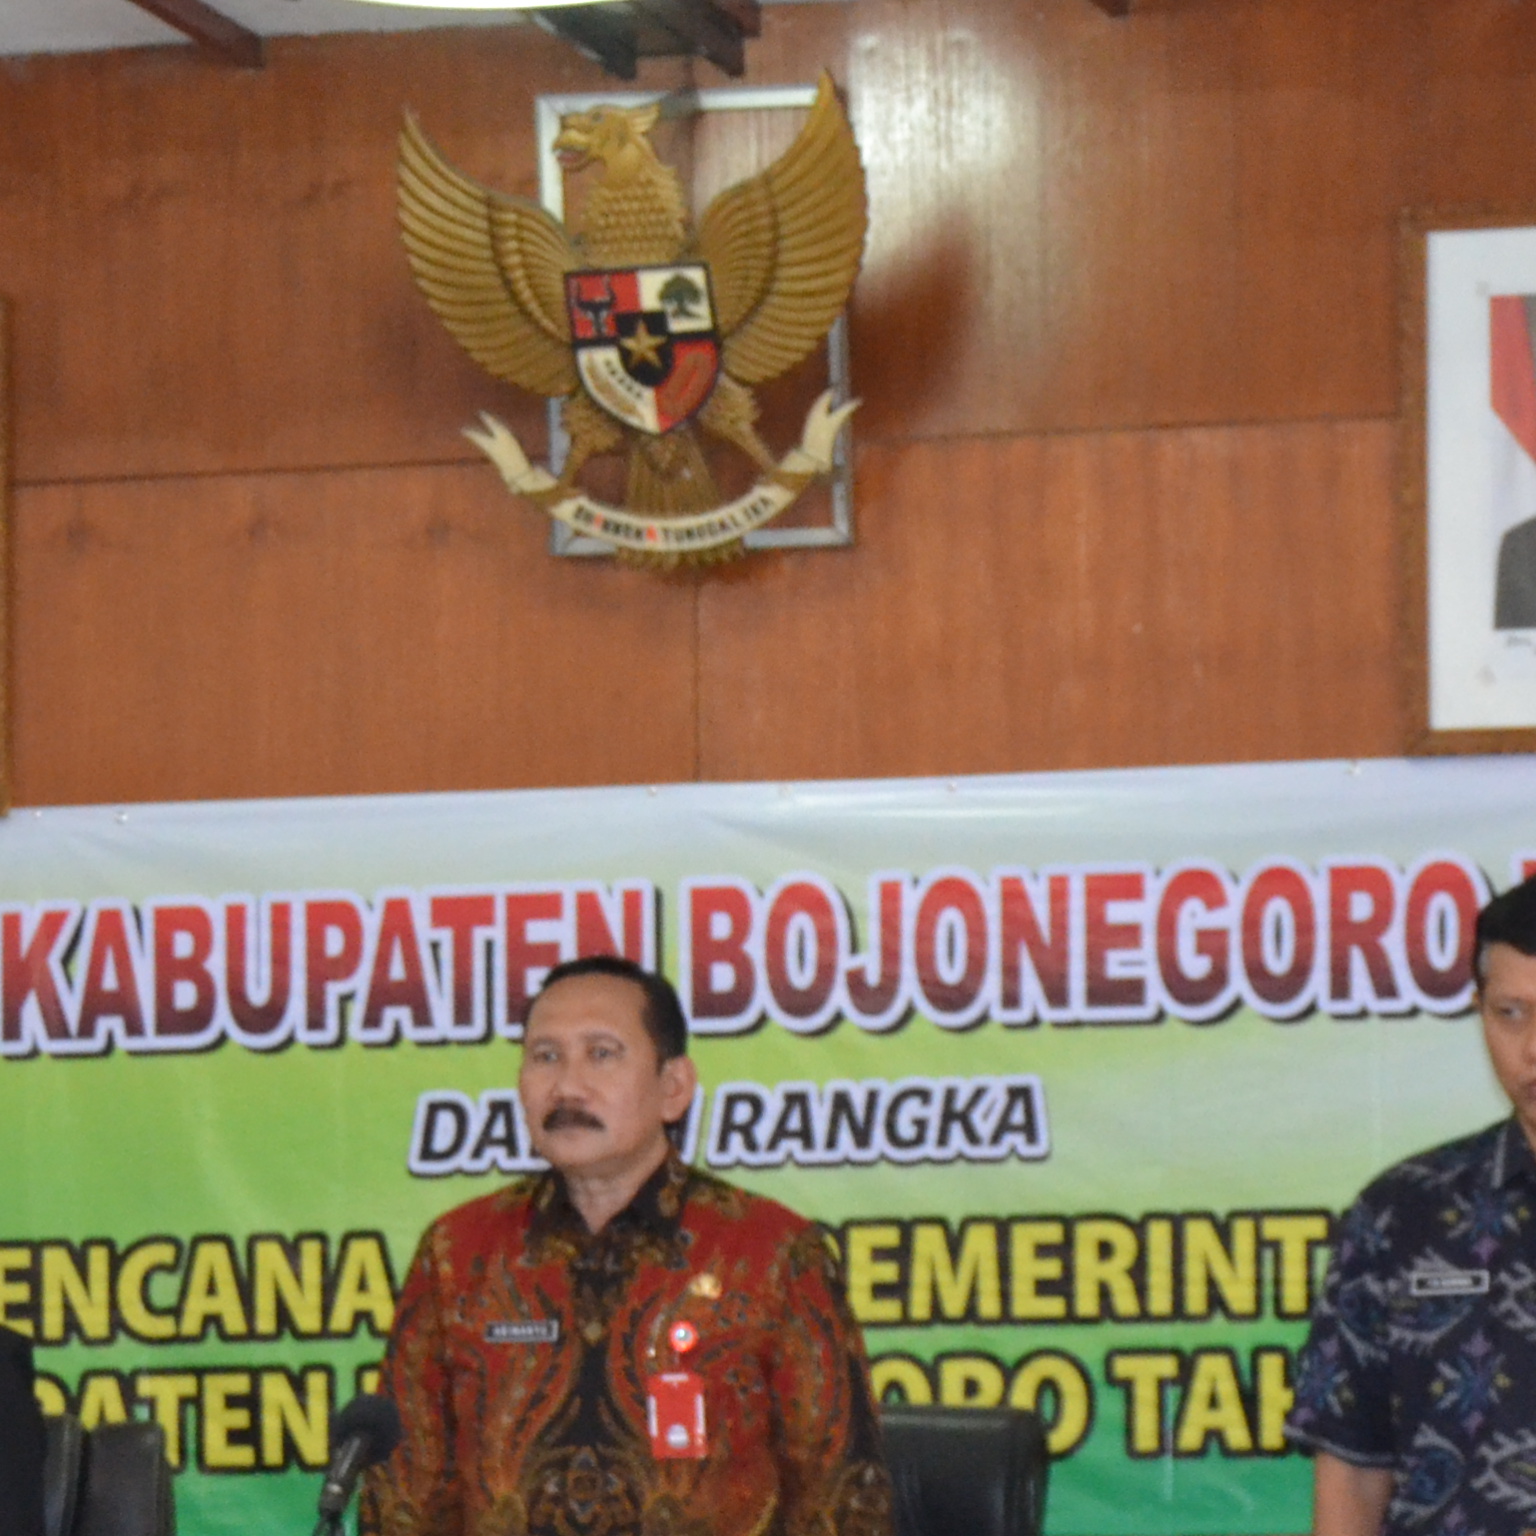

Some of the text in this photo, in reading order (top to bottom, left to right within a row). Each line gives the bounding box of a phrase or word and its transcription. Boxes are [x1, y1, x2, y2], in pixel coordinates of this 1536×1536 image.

[688, 857, 1480, 1021] BOJONEGORO
[715, 1082, 1041, 1157] RANGKA
[826, 1214, 1332, 1324] EMERINT
